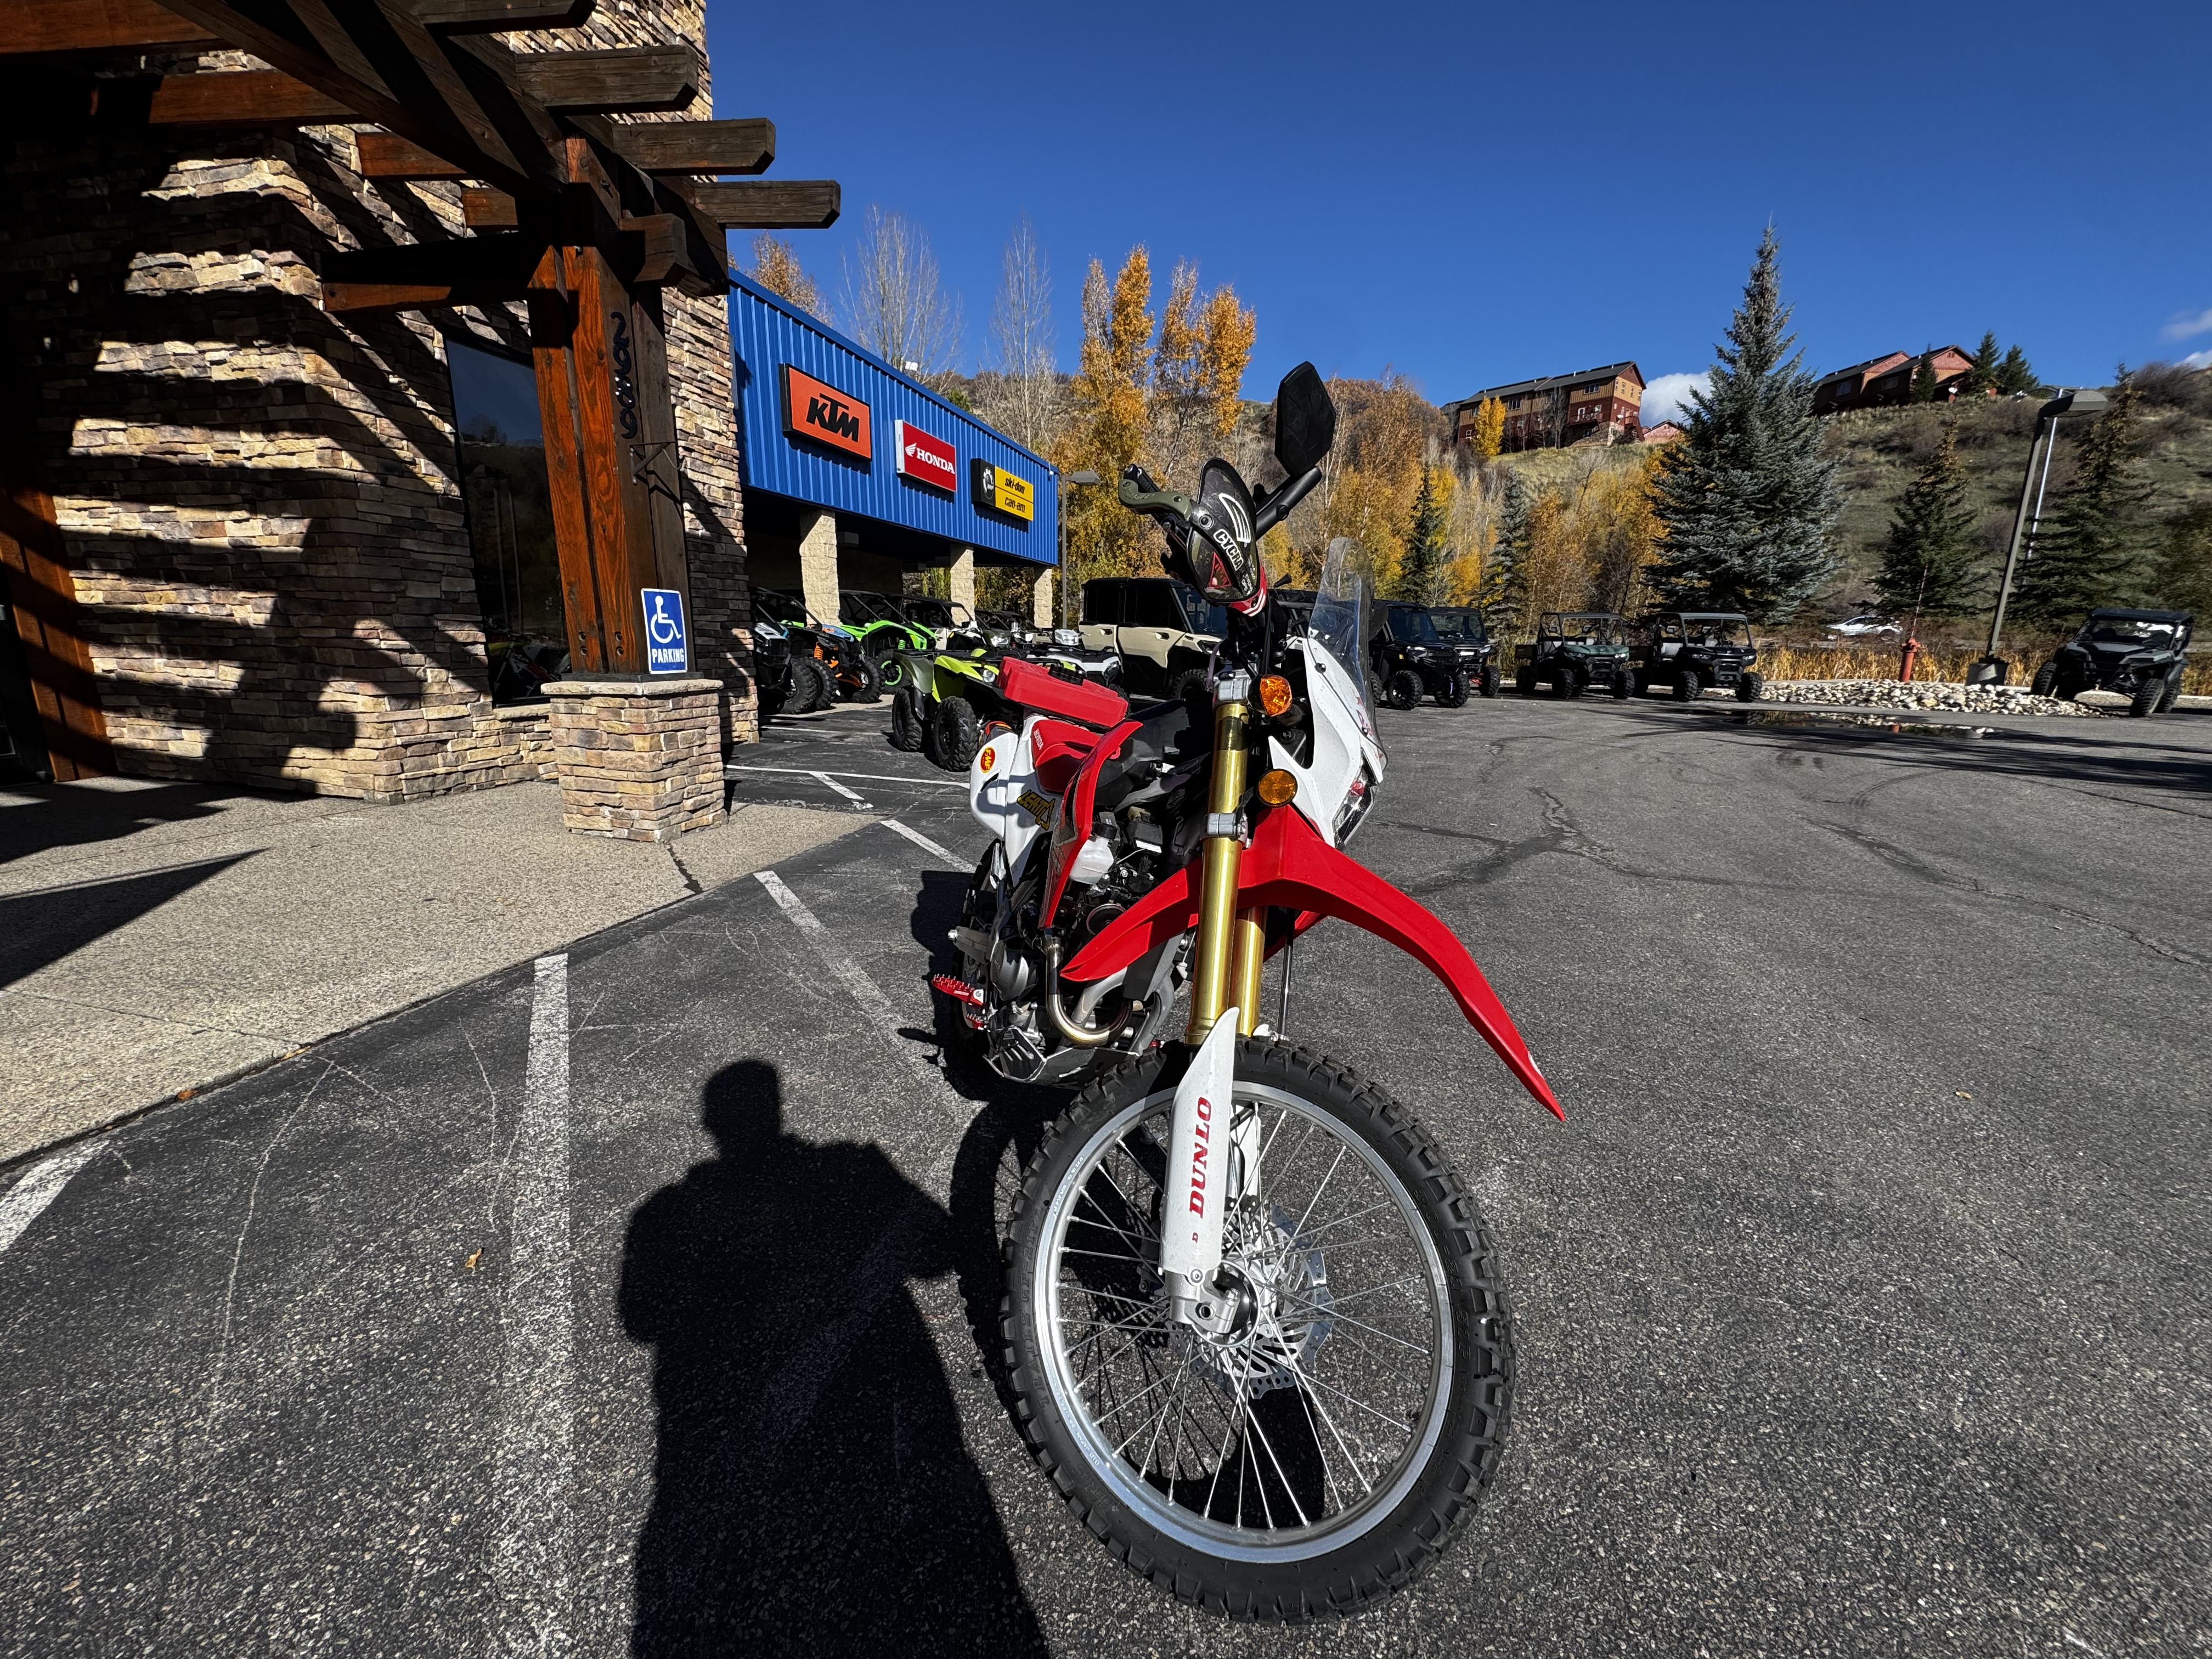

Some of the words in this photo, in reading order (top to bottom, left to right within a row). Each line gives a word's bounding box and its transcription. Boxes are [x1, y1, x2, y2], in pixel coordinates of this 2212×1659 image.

[611, 311, 638, 439] 2989
[806, 392, 860, 443] KTM
[916, 447, 955, 475] HONDA
[1005, 477, 1025, 494] ski-doo
[1005, 496, 1026, 513] can-am
[1213, 528, 1244, 572] CYCRA
[652, 648, 685, 663] PARKING
[1033, 728, 1044, 751] HONDA
[984, 748, 993, 770] FMF
[1021, 1313, 1051, 1410] TRAILS
